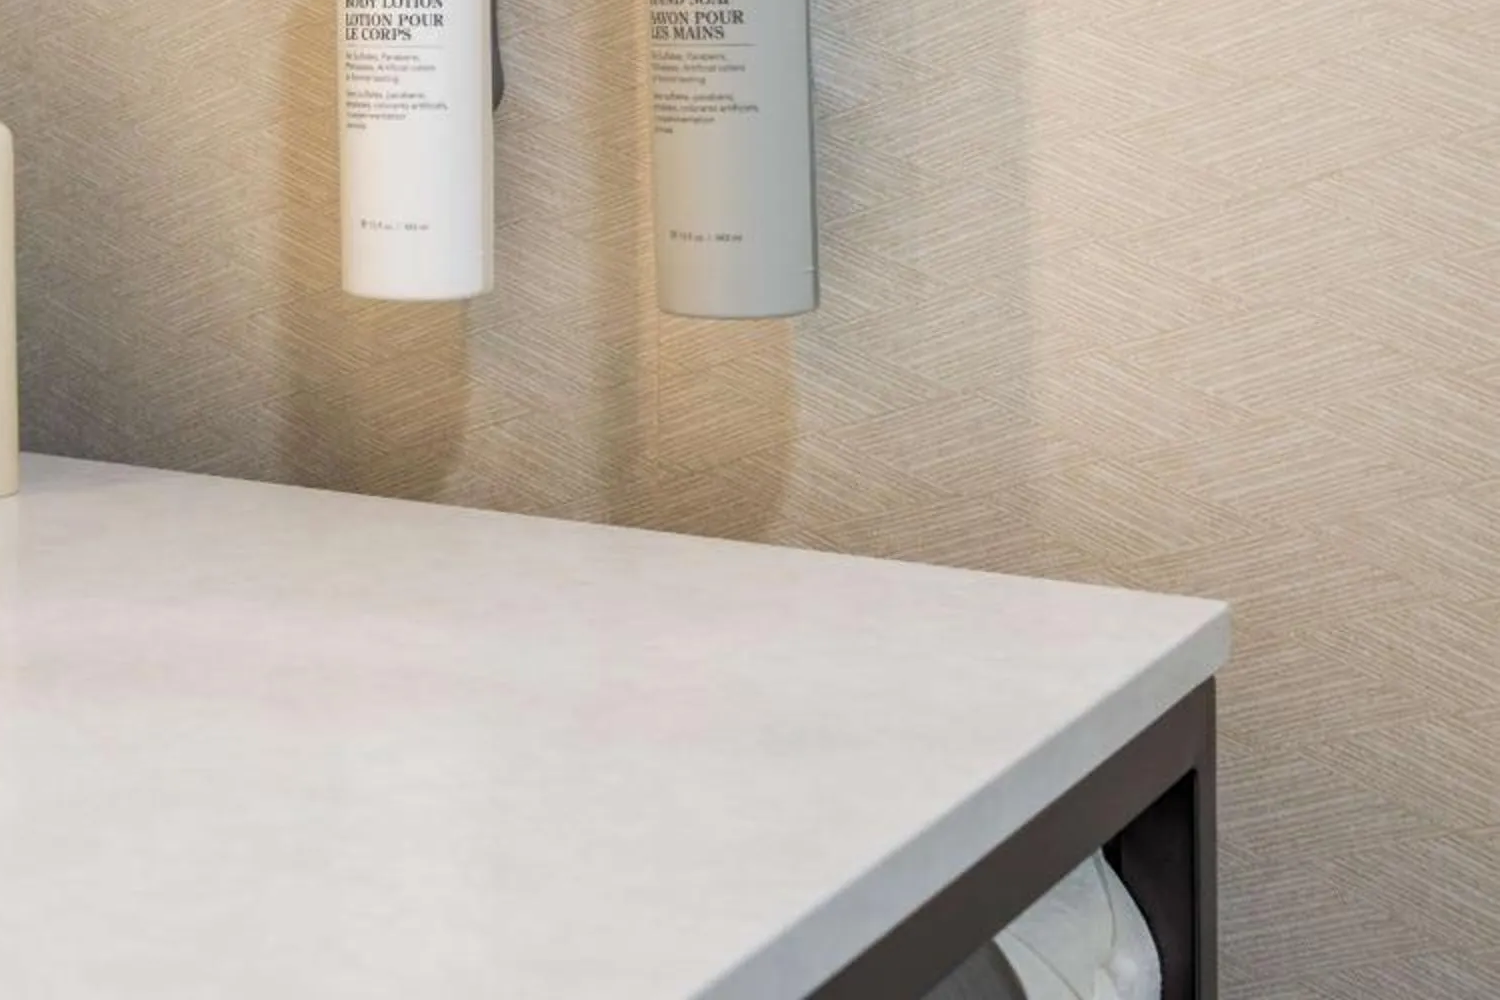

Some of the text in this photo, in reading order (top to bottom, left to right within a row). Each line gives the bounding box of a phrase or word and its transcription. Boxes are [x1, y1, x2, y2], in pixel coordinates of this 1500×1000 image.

[345, 13, 445, 27] LOTION POUR
[696, 10, 745, 25] POUR
[345, 27, 412, 41] LE CORPS
[673, 25, 725, 40] MAINS
